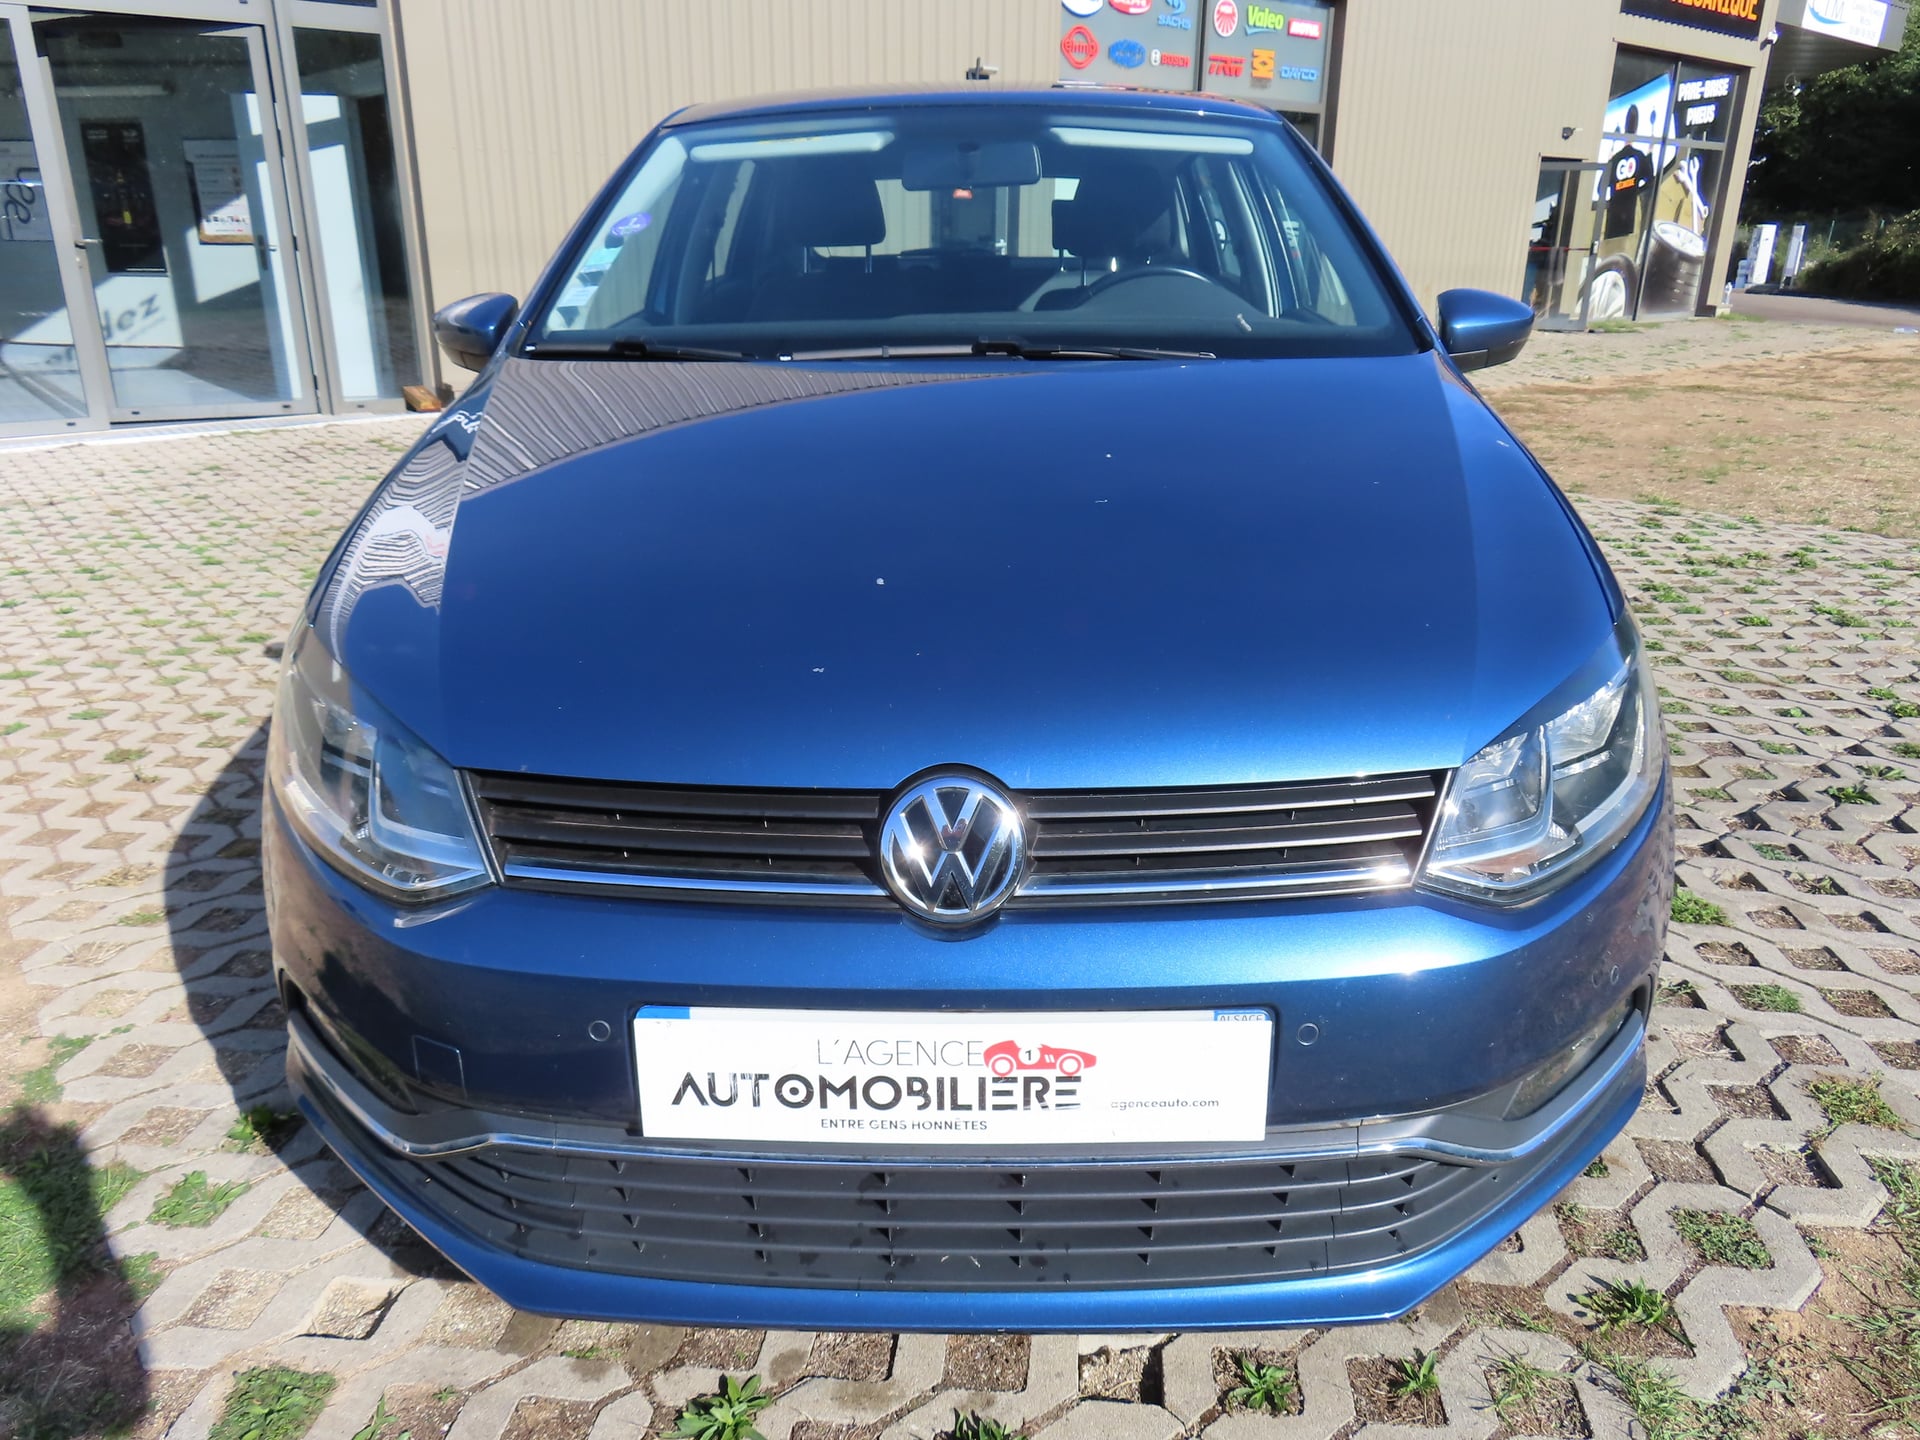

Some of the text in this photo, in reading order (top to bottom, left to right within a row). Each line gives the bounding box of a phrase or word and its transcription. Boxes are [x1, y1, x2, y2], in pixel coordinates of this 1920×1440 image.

[1247, 5, 1284, 30] Valeo
[1161, 53, 1190, 68] BOSCH
[1209, 54, 1245, 77] TRW
[1281, 65, 1317, 81] DAYCO
[1678, 78, 1729, 102] PARE-BRISE
[1686, 104, 1715, 126] PNEUS
[817, 1039, 984, 1067] L'AGENCE
[1110, 1097, 1220, 1111] agenceauto.com
[820, 1118, 865, 1129] ENTRE
[869, 1119, 907, 1130] GENS
